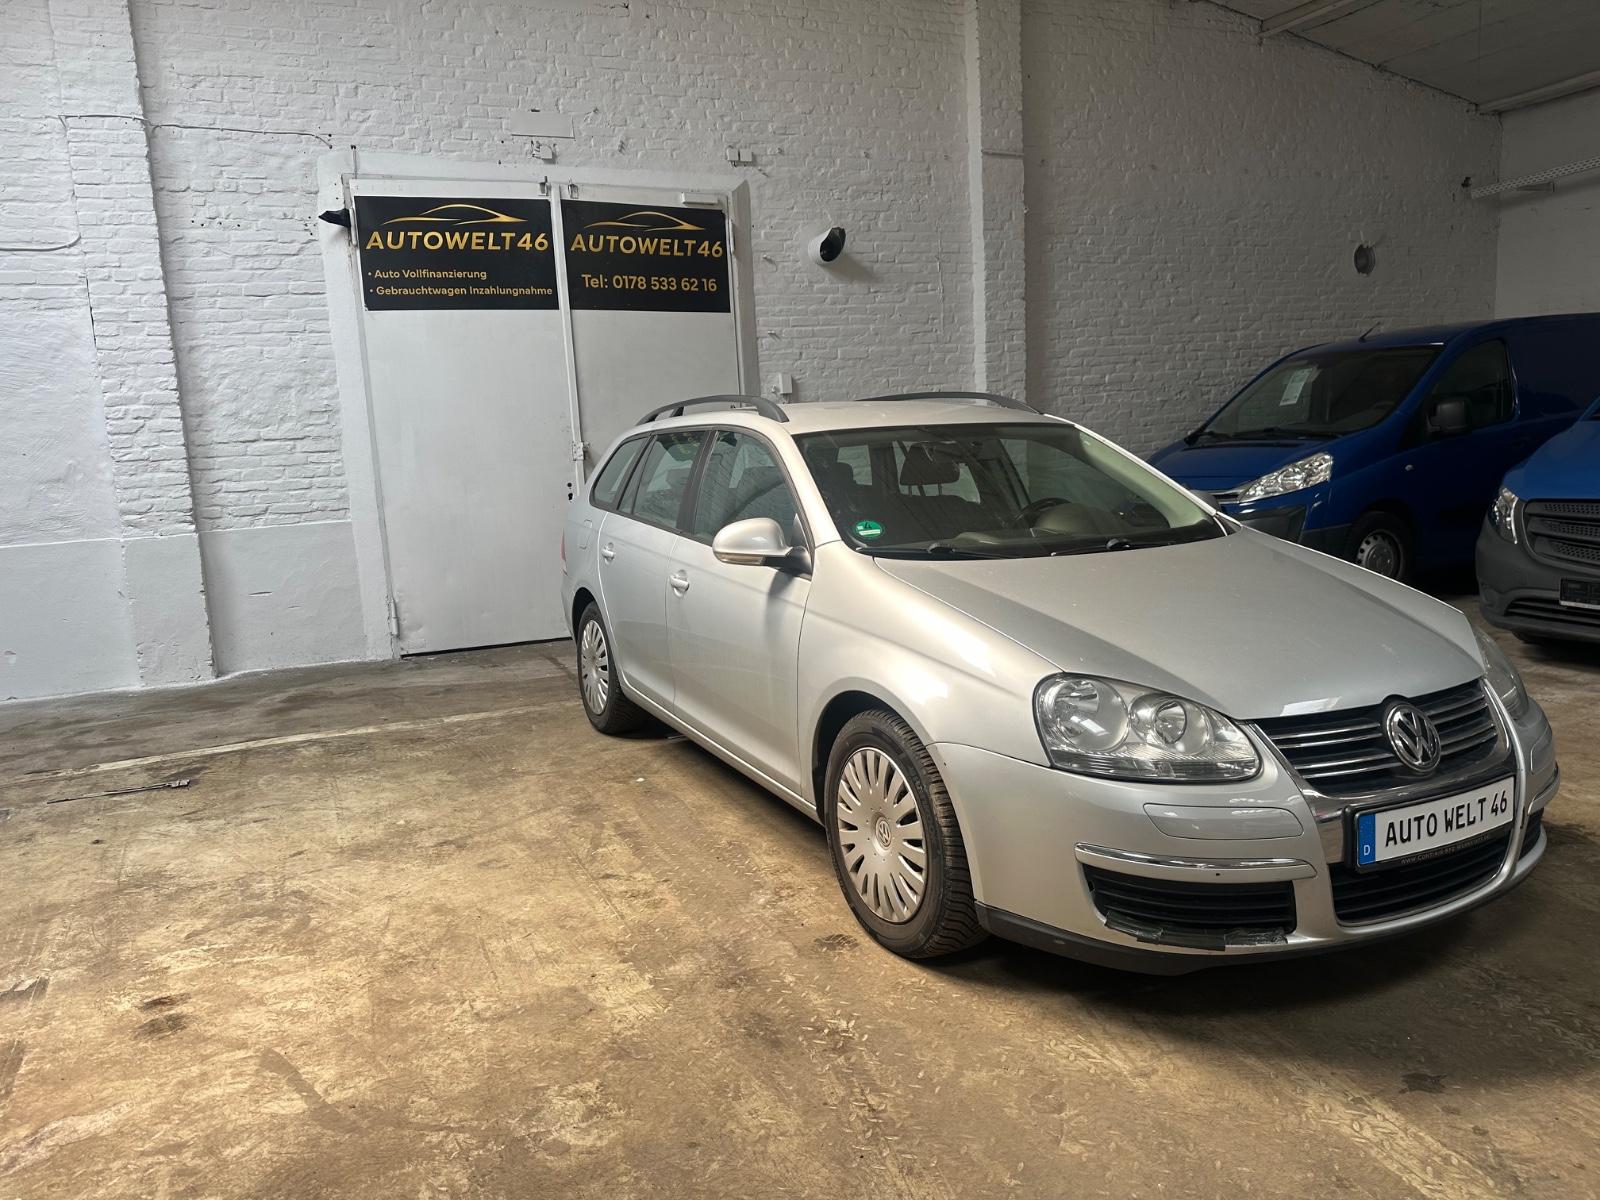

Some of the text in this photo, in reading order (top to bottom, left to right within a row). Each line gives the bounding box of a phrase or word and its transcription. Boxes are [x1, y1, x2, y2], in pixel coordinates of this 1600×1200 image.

[374, 269, 487, 280] Auto Vollfinanzierung
[581, 274, 717, 292] Tel: 0178 533 62 16
[376, 285, 553, 297] Gebrauchtwagen Inzahlungnahme
[1385, 790, 1508, 847] AUTO WELT 46
[1363, 844, 1371, 856] D
